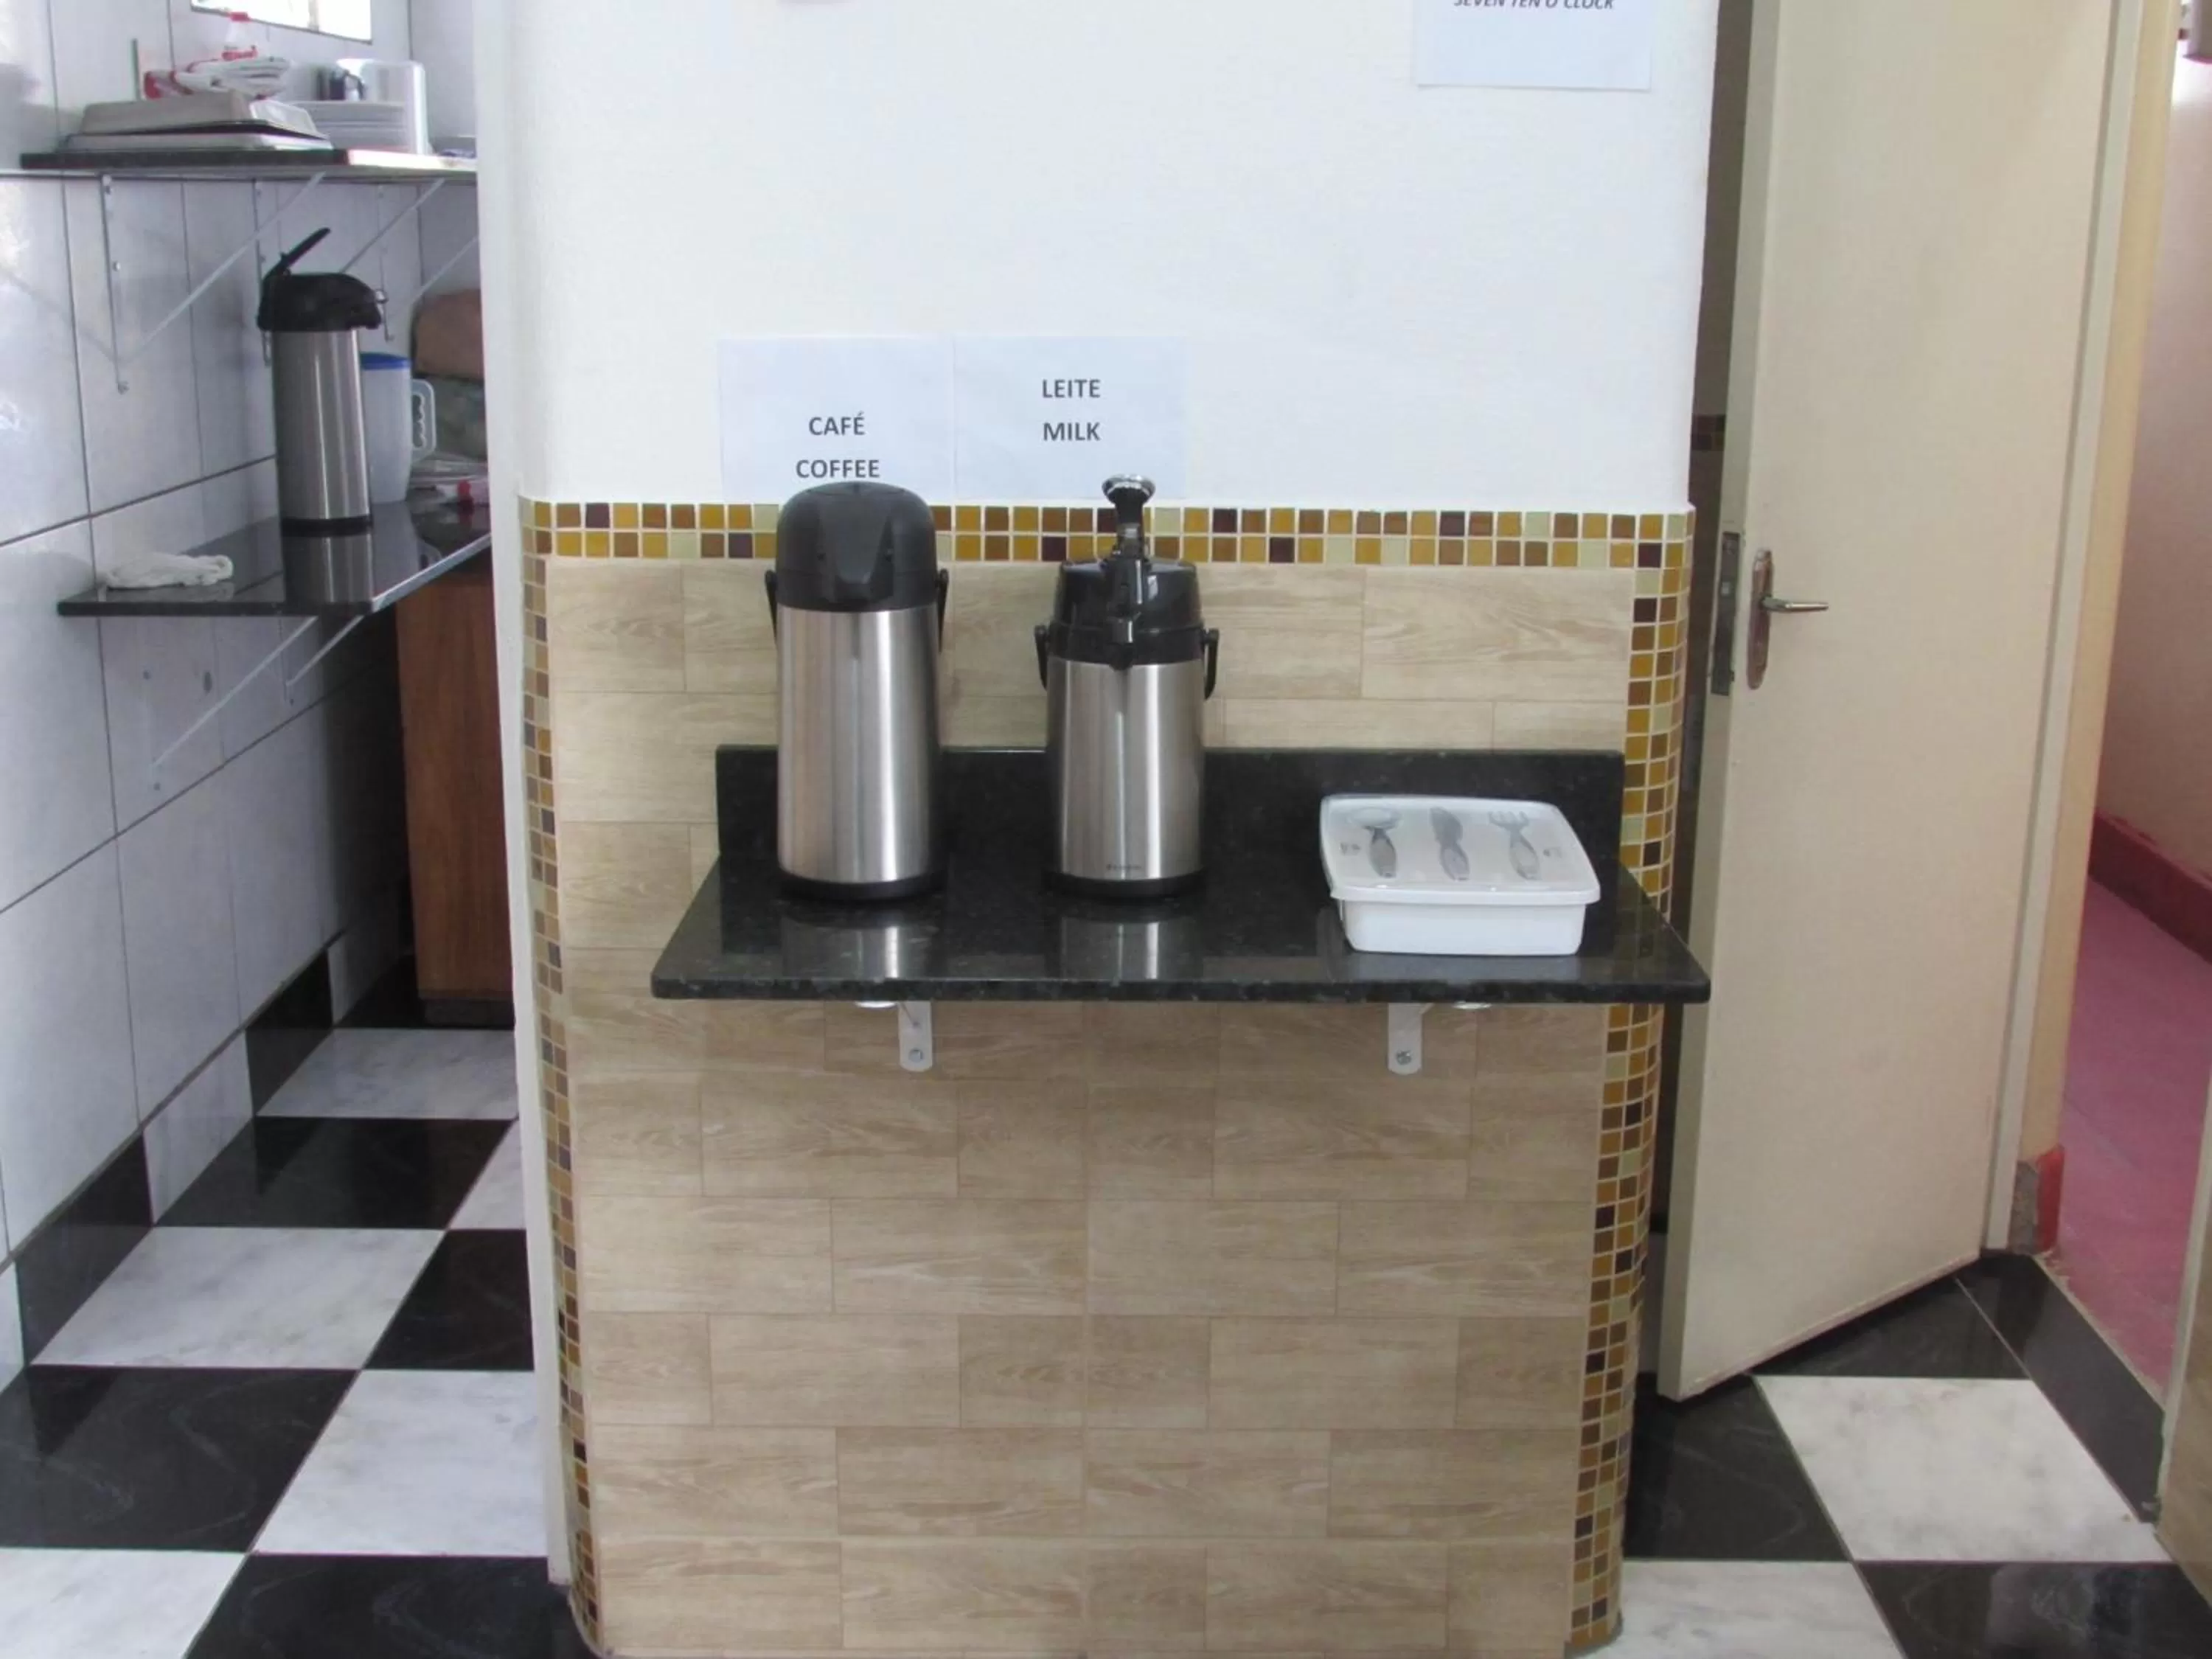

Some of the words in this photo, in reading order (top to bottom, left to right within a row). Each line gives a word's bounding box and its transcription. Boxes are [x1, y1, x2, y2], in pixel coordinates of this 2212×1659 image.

[1042, 378, 1101, 399] LEITE
[808, 411, 865, 436] CAFÉ
[1043, 422, 1101, 442] MILK
[796, 459, 880, 479] COFFEE
